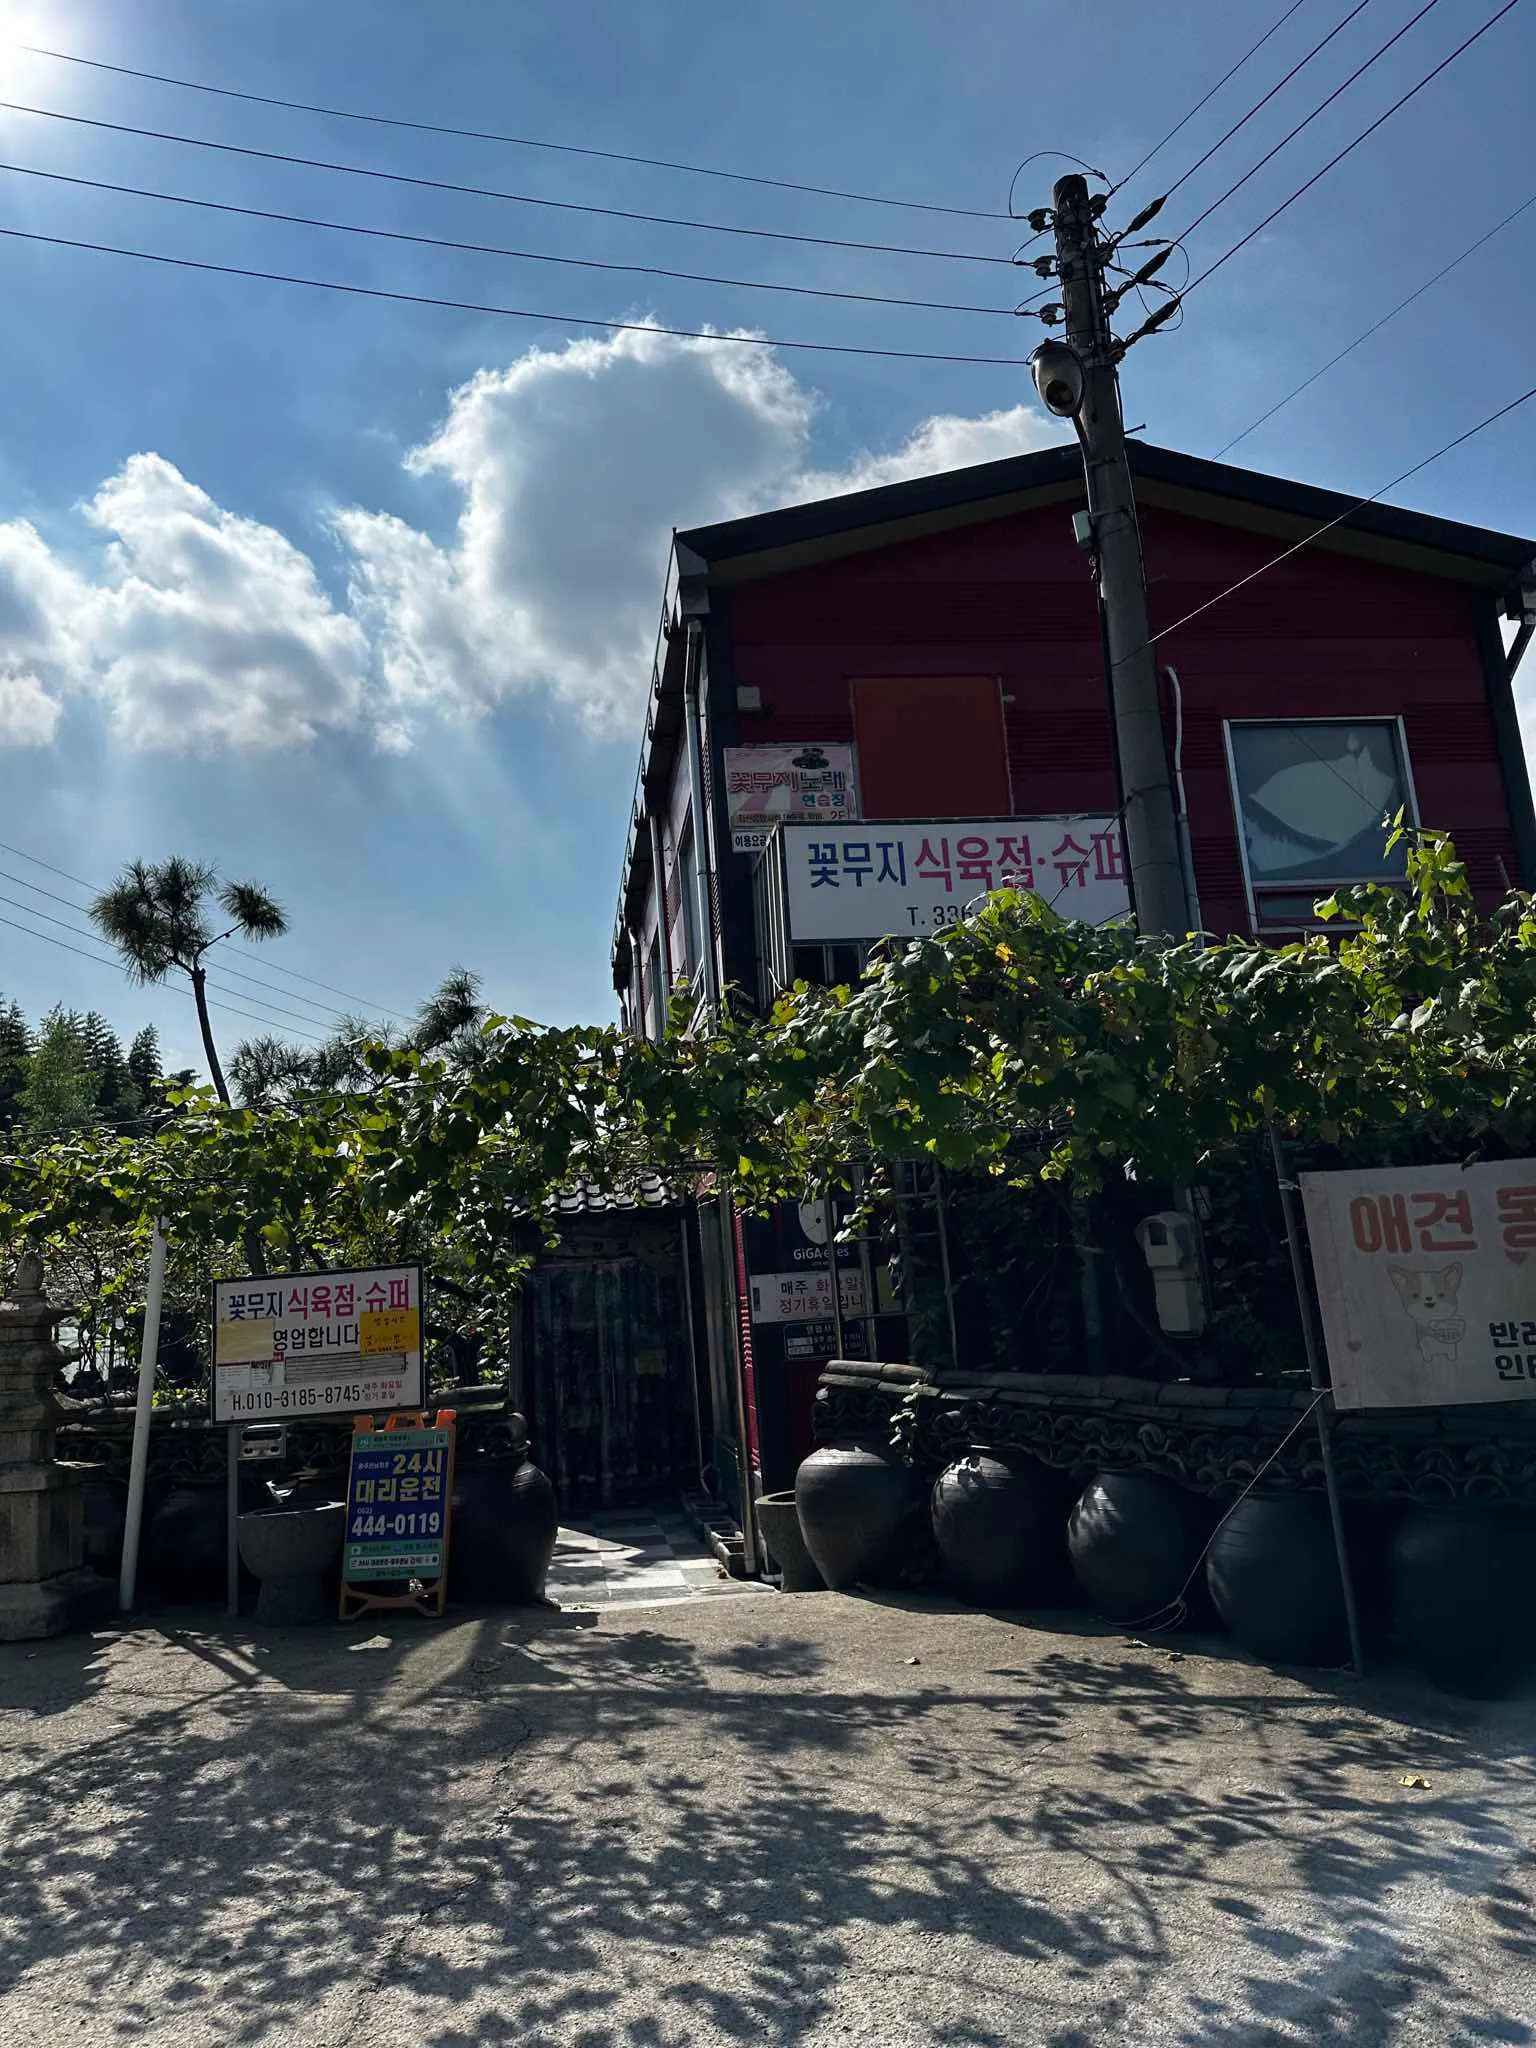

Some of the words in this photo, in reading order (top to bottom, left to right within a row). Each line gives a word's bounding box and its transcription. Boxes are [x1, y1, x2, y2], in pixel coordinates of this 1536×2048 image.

[800, 770, 846, 792] 노래
[801, 793, 845, 808] 연습장
[807, 841, 906, 888] 꽃무지
[1350, 1189, 1479, 1253] 애견
[781, 1280, 808, 1295] 매주
[229, 1291, 283, 1321] 꽃무지
[273, 1323, 360, 1352] 영업합니다
[392, 1448, 443, 1475] 24시
[355, 1475, 441, 1504] 대리운전
[351, 1511, 440, 1537] 444-0119
